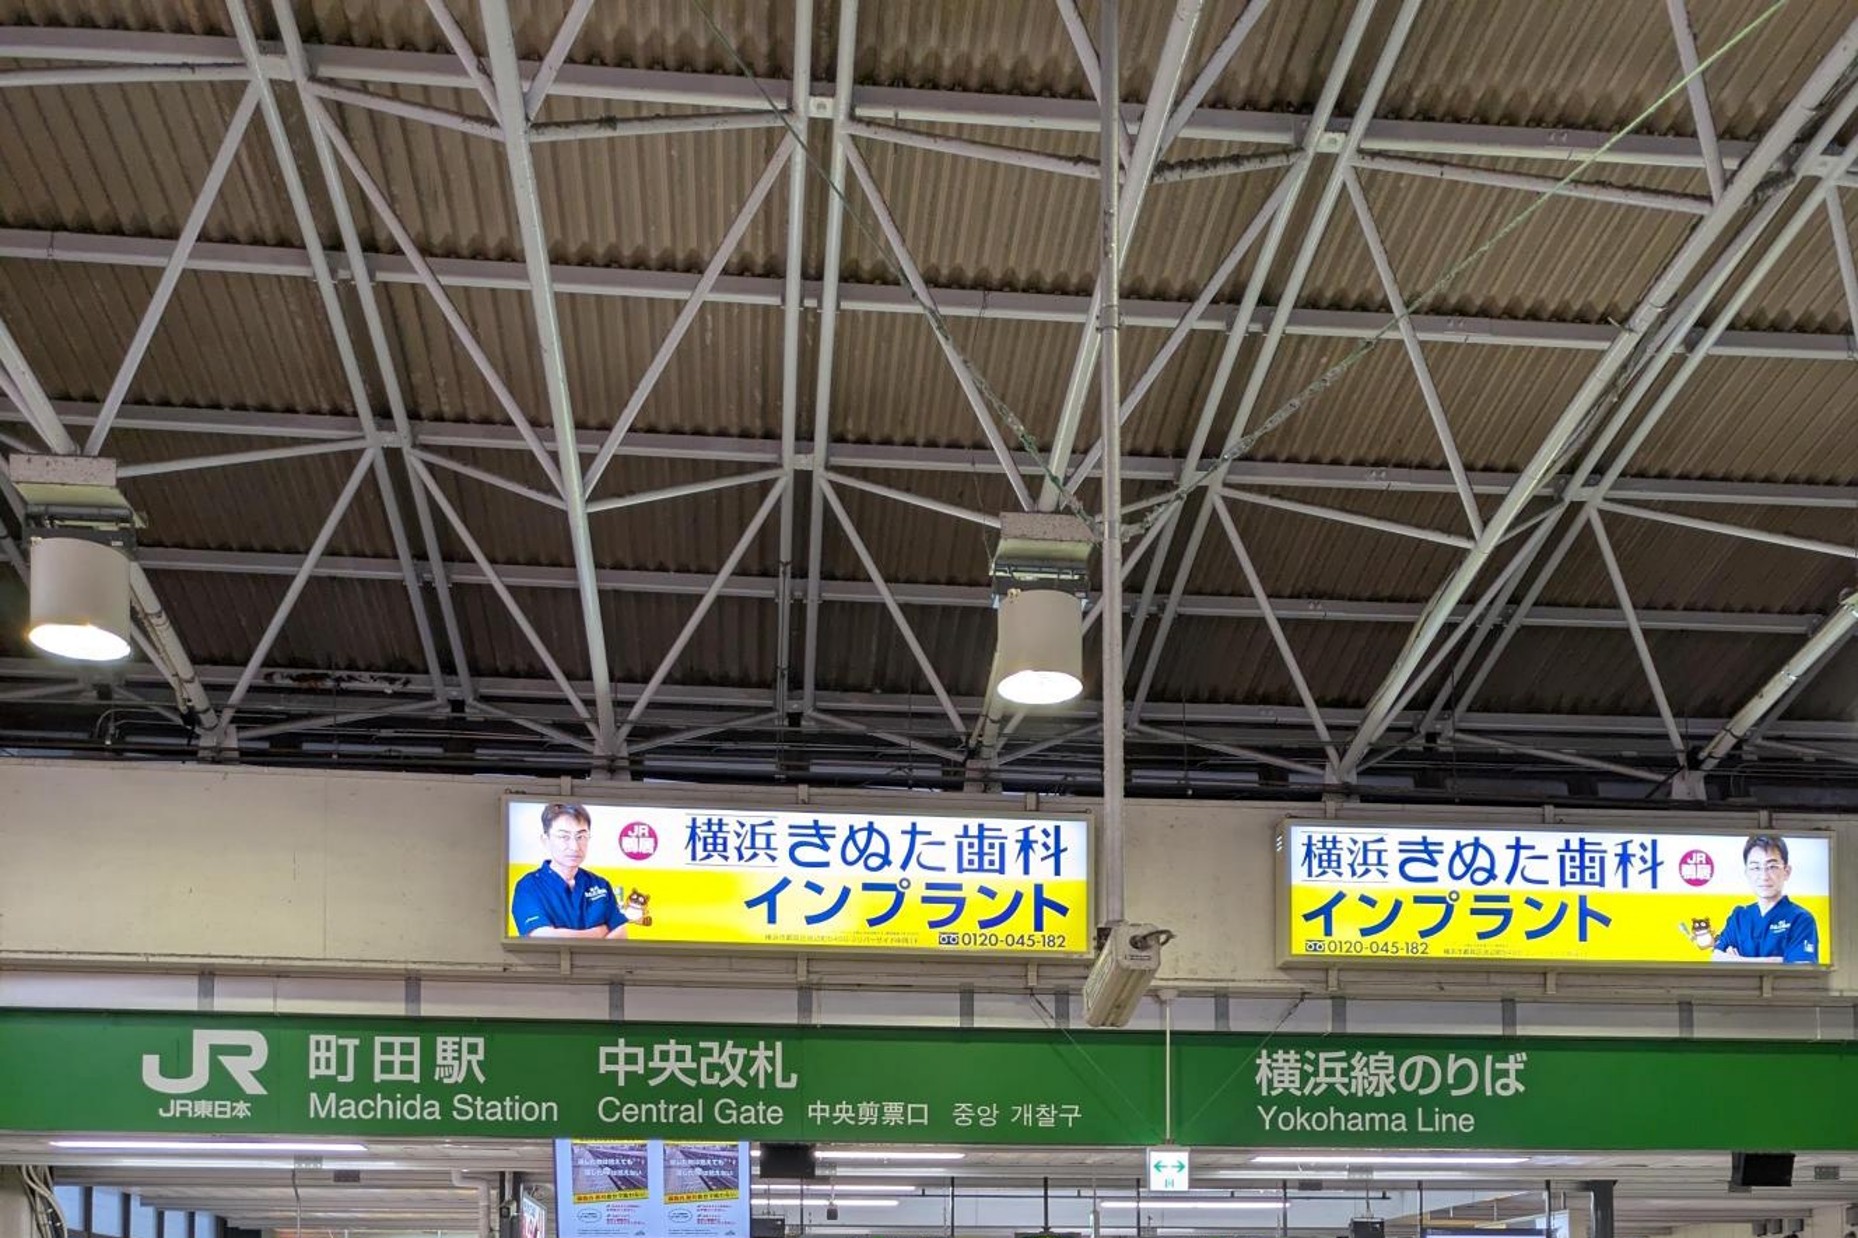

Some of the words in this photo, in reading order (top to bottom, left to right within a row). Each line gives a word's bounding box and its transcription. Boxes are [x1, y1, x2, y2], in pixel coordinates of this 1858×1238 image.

[685, 812, 1068, 876] 横浜きぬた歯科
[1301, 831, 1664, 889] 横浜きぬた歯科
[745, 877, 1069, 932] インプラント
[1302, 890, 1612, 942] インプラント
[962, 932, 1066, 949] 0120-045-182
[1328, 940, 1429, 955] 0120-045-182
[142, 1029, 268, 1094] JR
[308, 1035, 486, 1085] 町田駅
[598, 1038, 798, 1089] 中央改札
[1255, 1049, 1528, 1098] 横浜線のりば
[159, 1100, 252, 1119] JR東日本
[309, 1092, 441, 1121] Machida
[452, 1093, 559, 1122] Station
[598, 1097, 703, 1123] Central
[714, 1098, 785, 1124] Gate
[807, 1102, 929, 1126] 中央剪票口
[952, 1103, 999, 1127] 중앙
[1011, 1103, 1083, 1128] 개찰구
[1256, 1106, 1407, 1132] Yokohama
[1417, 1108, 1475, 1133] Line
